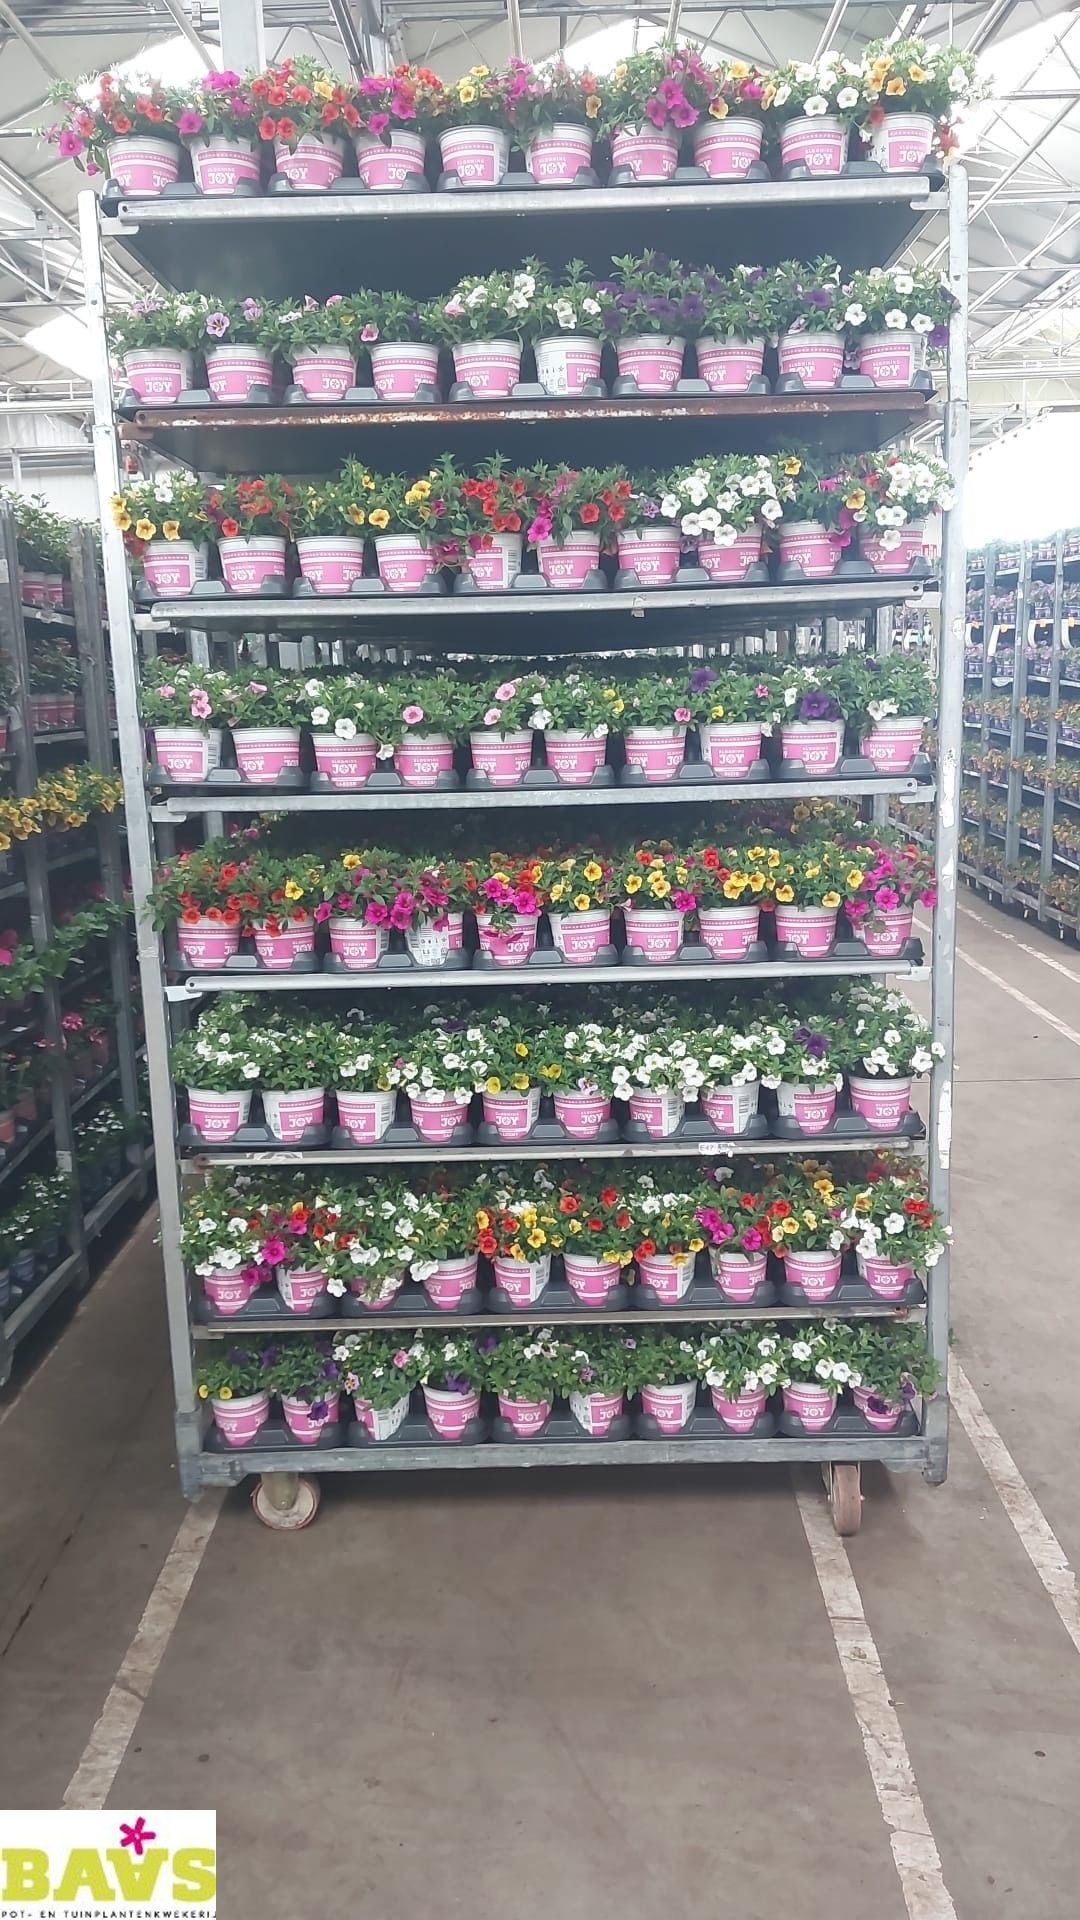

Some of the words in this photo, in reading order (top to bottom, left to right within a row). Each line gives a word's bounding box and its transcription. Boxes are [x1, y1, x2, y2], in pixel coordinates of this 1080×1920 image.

[805, 153, 833, 166] JOY
[457, 164, 484, 176] JOY
[539, 161, 566, 175] JOY
[873, 365, 900, 377] JOY
[145, 381, 172, 393] JOY
[322, 378, 348, 390] JOY
[549, 564, 574, 575] JOY
[633, 560, 660, 572] JOY
[155, 572, 180, 584] JOY
[231, 569, 256, 581] JOY
[802, 750, 828, 761] JOY
[870, 747, 896, 758] JOY
[168, 758, 193, 769] JOY
[554, 758, 578, 769] JOY
[719, 753, 745, 764] JOY
[242, 759, 264, 771] JOY
[331, 764, 358, 774] JOY
[413, 762, 440, 773] JOY
[873, 931, 898, 942] JOY
[571, 939, 596, 949] JOY
[647, 938, 672, 949] JOY
[343, 946, 368, 956] JOY
[804, 1109, 828, 1120] JOY
[875, 1107, 900, 1117] JOY
[204, 1118, 231, 1128] JOY
[496, 1115, 520, 1126] JOY
[801, 1276, 826, 1287] JOY
[874, 1274, 899, 1285] JOY
[217, 1290, 242, 1299] JOY
[517, 1411, 541, 1421] JOY
[802, 1407, 826, 1417] JOY
